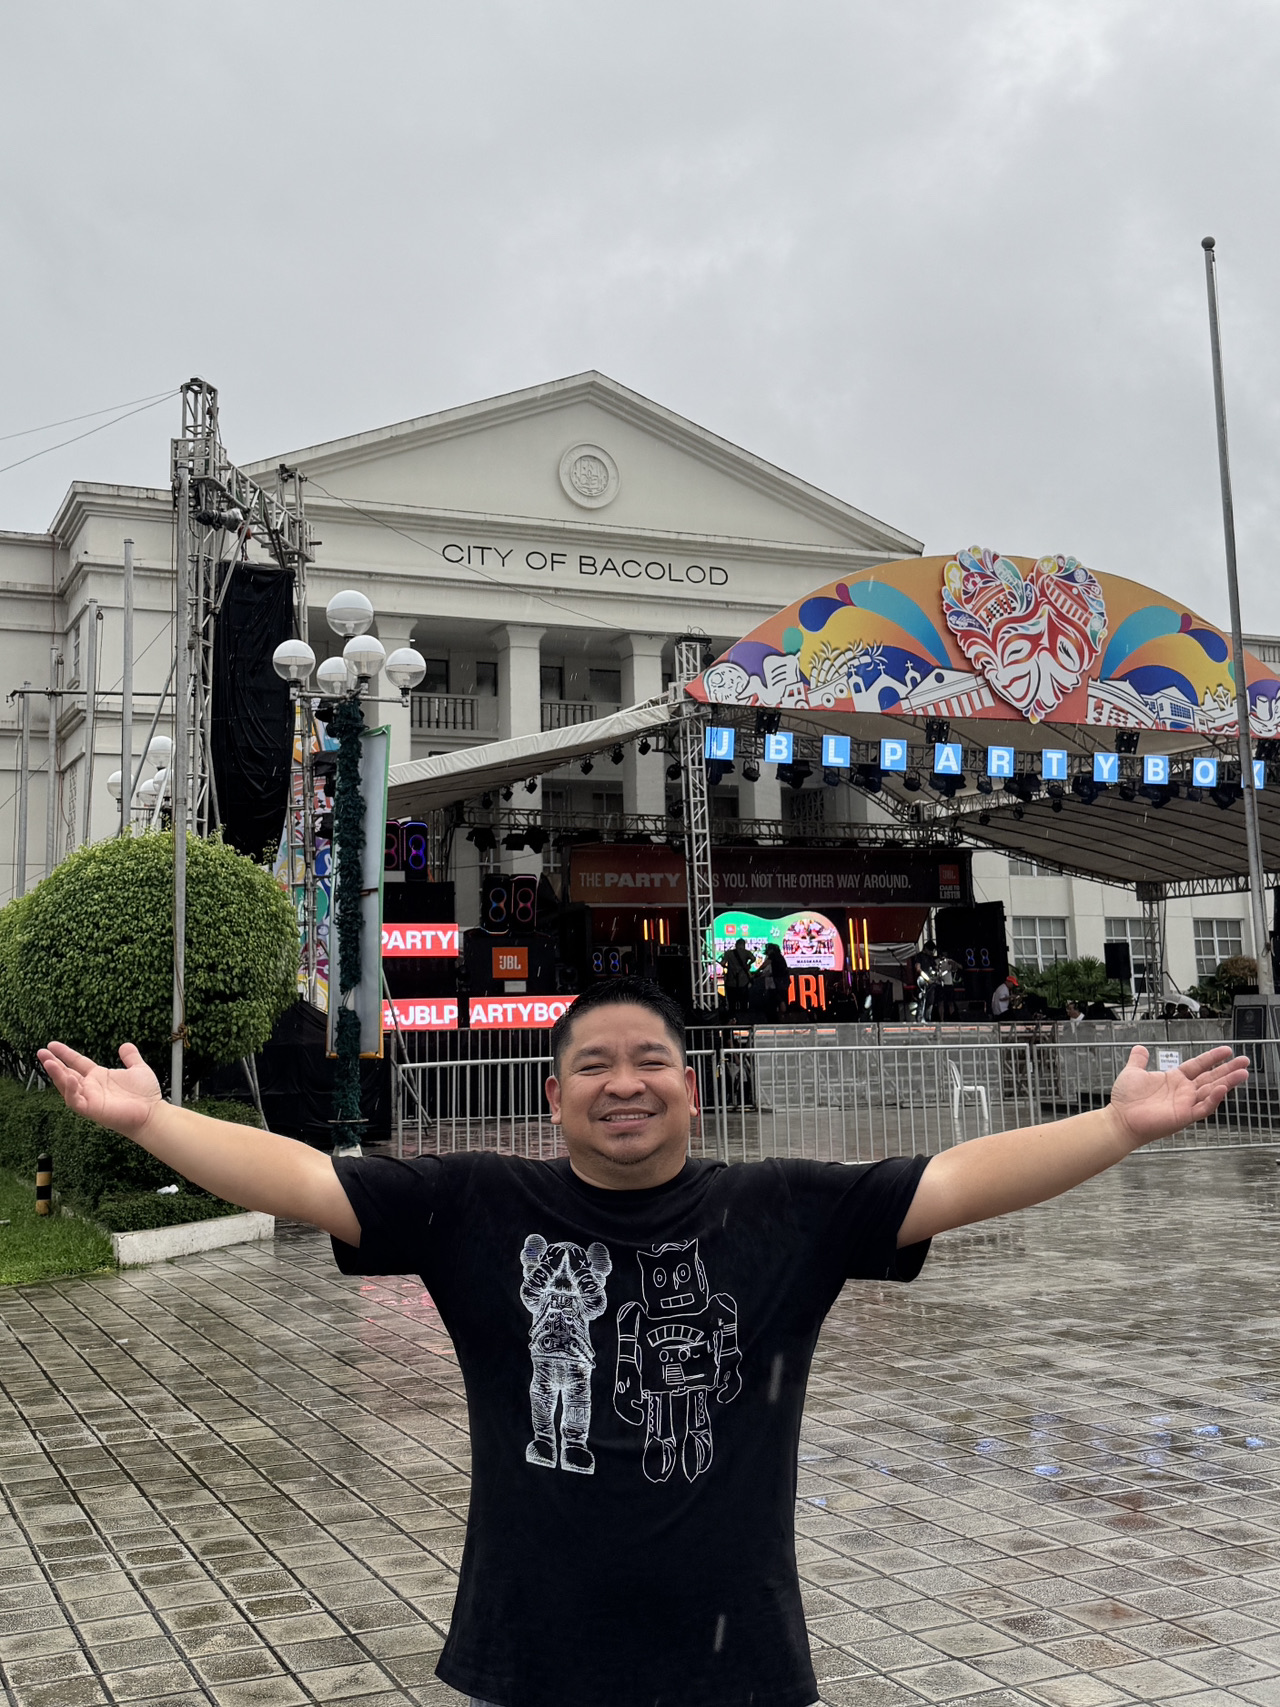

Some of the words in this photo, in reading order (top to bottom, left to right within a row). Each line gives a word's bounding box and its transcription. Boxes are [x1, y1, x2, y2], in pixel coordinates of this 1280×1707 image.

[442, 544, 513, 567] CITY
[525, 551, 567, 571] OF
[579, 555, 729, 586] BACOLOD
[579, 873, 602, 888] THE
[604, 872, 681, 888] PARTY
[722, 873, 748, 888] YOU.
[751, 873, 773, 888] NOT
[776, 874, 797, 888] THE
[799, 873, 834, 888] OTHER
[837, 873, 861, 888] WAY
[863, 873, 912, 888] AROUND.
[499, 955, 522, 970] JBL
